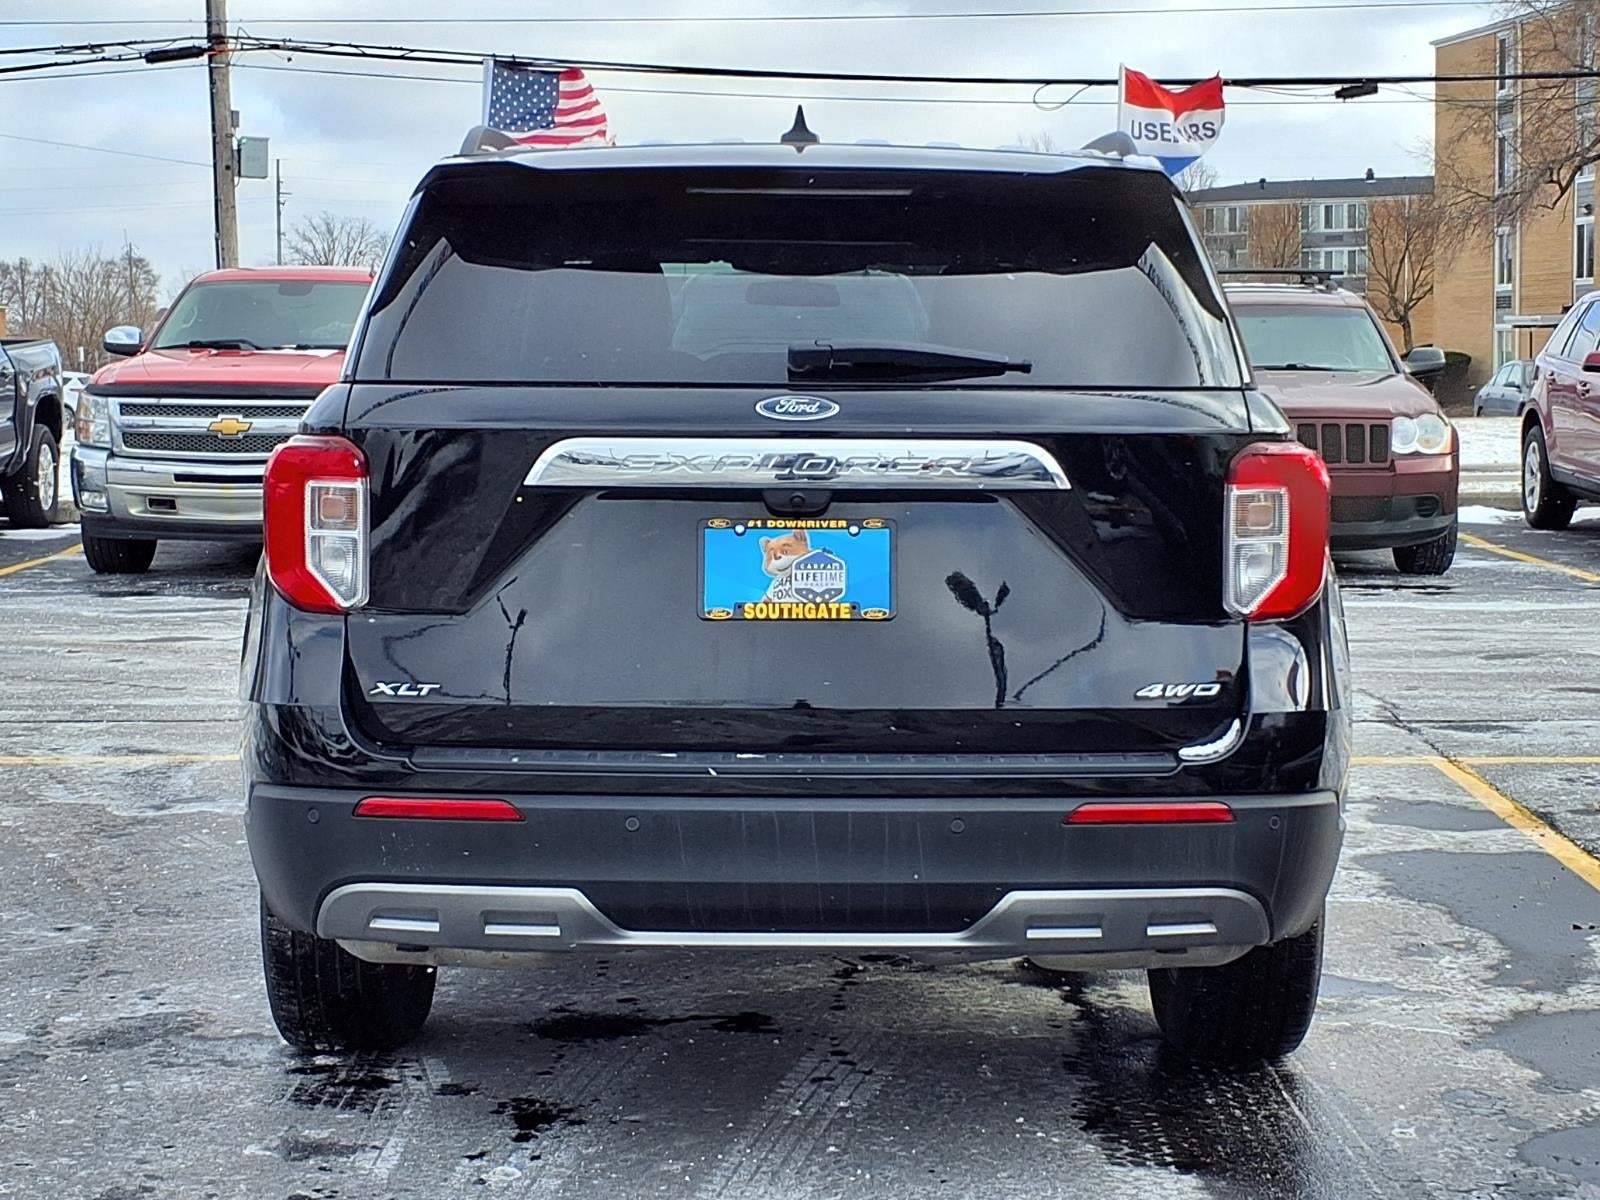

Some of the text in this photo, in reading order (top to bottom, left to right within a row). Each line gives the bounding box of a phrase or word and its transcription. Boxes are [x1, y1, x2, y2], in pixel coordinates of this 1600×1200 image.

[1131, 120, 1179, 143] USE
[775, 399, 820, 413] Ford
[616, 454, 972, 475] EXPLORER
[747, 520, 847, 528] #1 DOWNRIVER
[794, 572, 844, 581] LIFETIME
[773, 588, 792, 600] FOX
[743, 602, 851, 619] SOUTHGATE
[369, 682, 441, 696] XLT
[1136, 683, 1221, 698] 4WD
